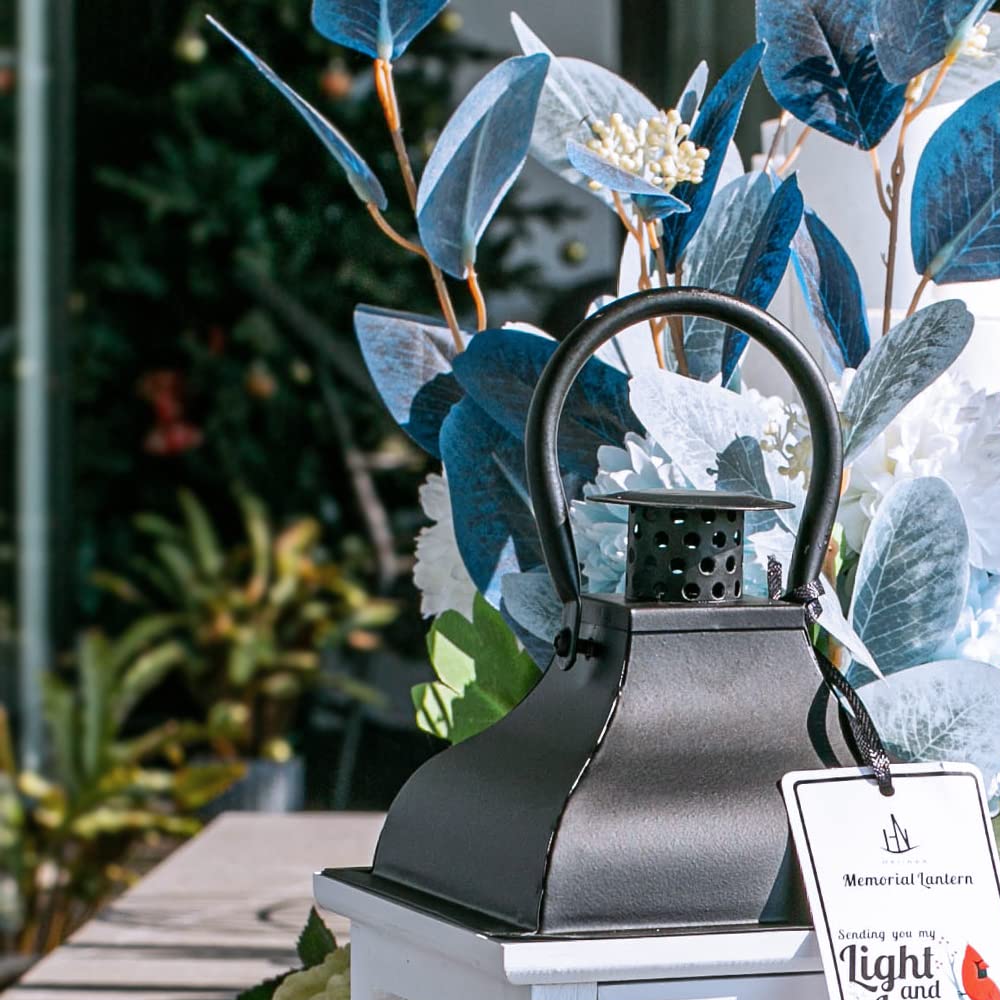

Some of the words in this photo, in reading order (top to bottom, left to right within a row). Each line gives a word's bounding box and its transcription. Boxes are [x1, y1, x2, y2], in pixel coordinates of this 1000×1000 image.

[843, 873, 915, 887] Memorial
[917, 873, 973, 888] Lantern
[838, 929, 885, 941] Sending
[892, 930, 912, 940] you
[919, 930, 936, 940] my
[840, 945, 934, 992] Light
[901, 980, 941, 999] and
